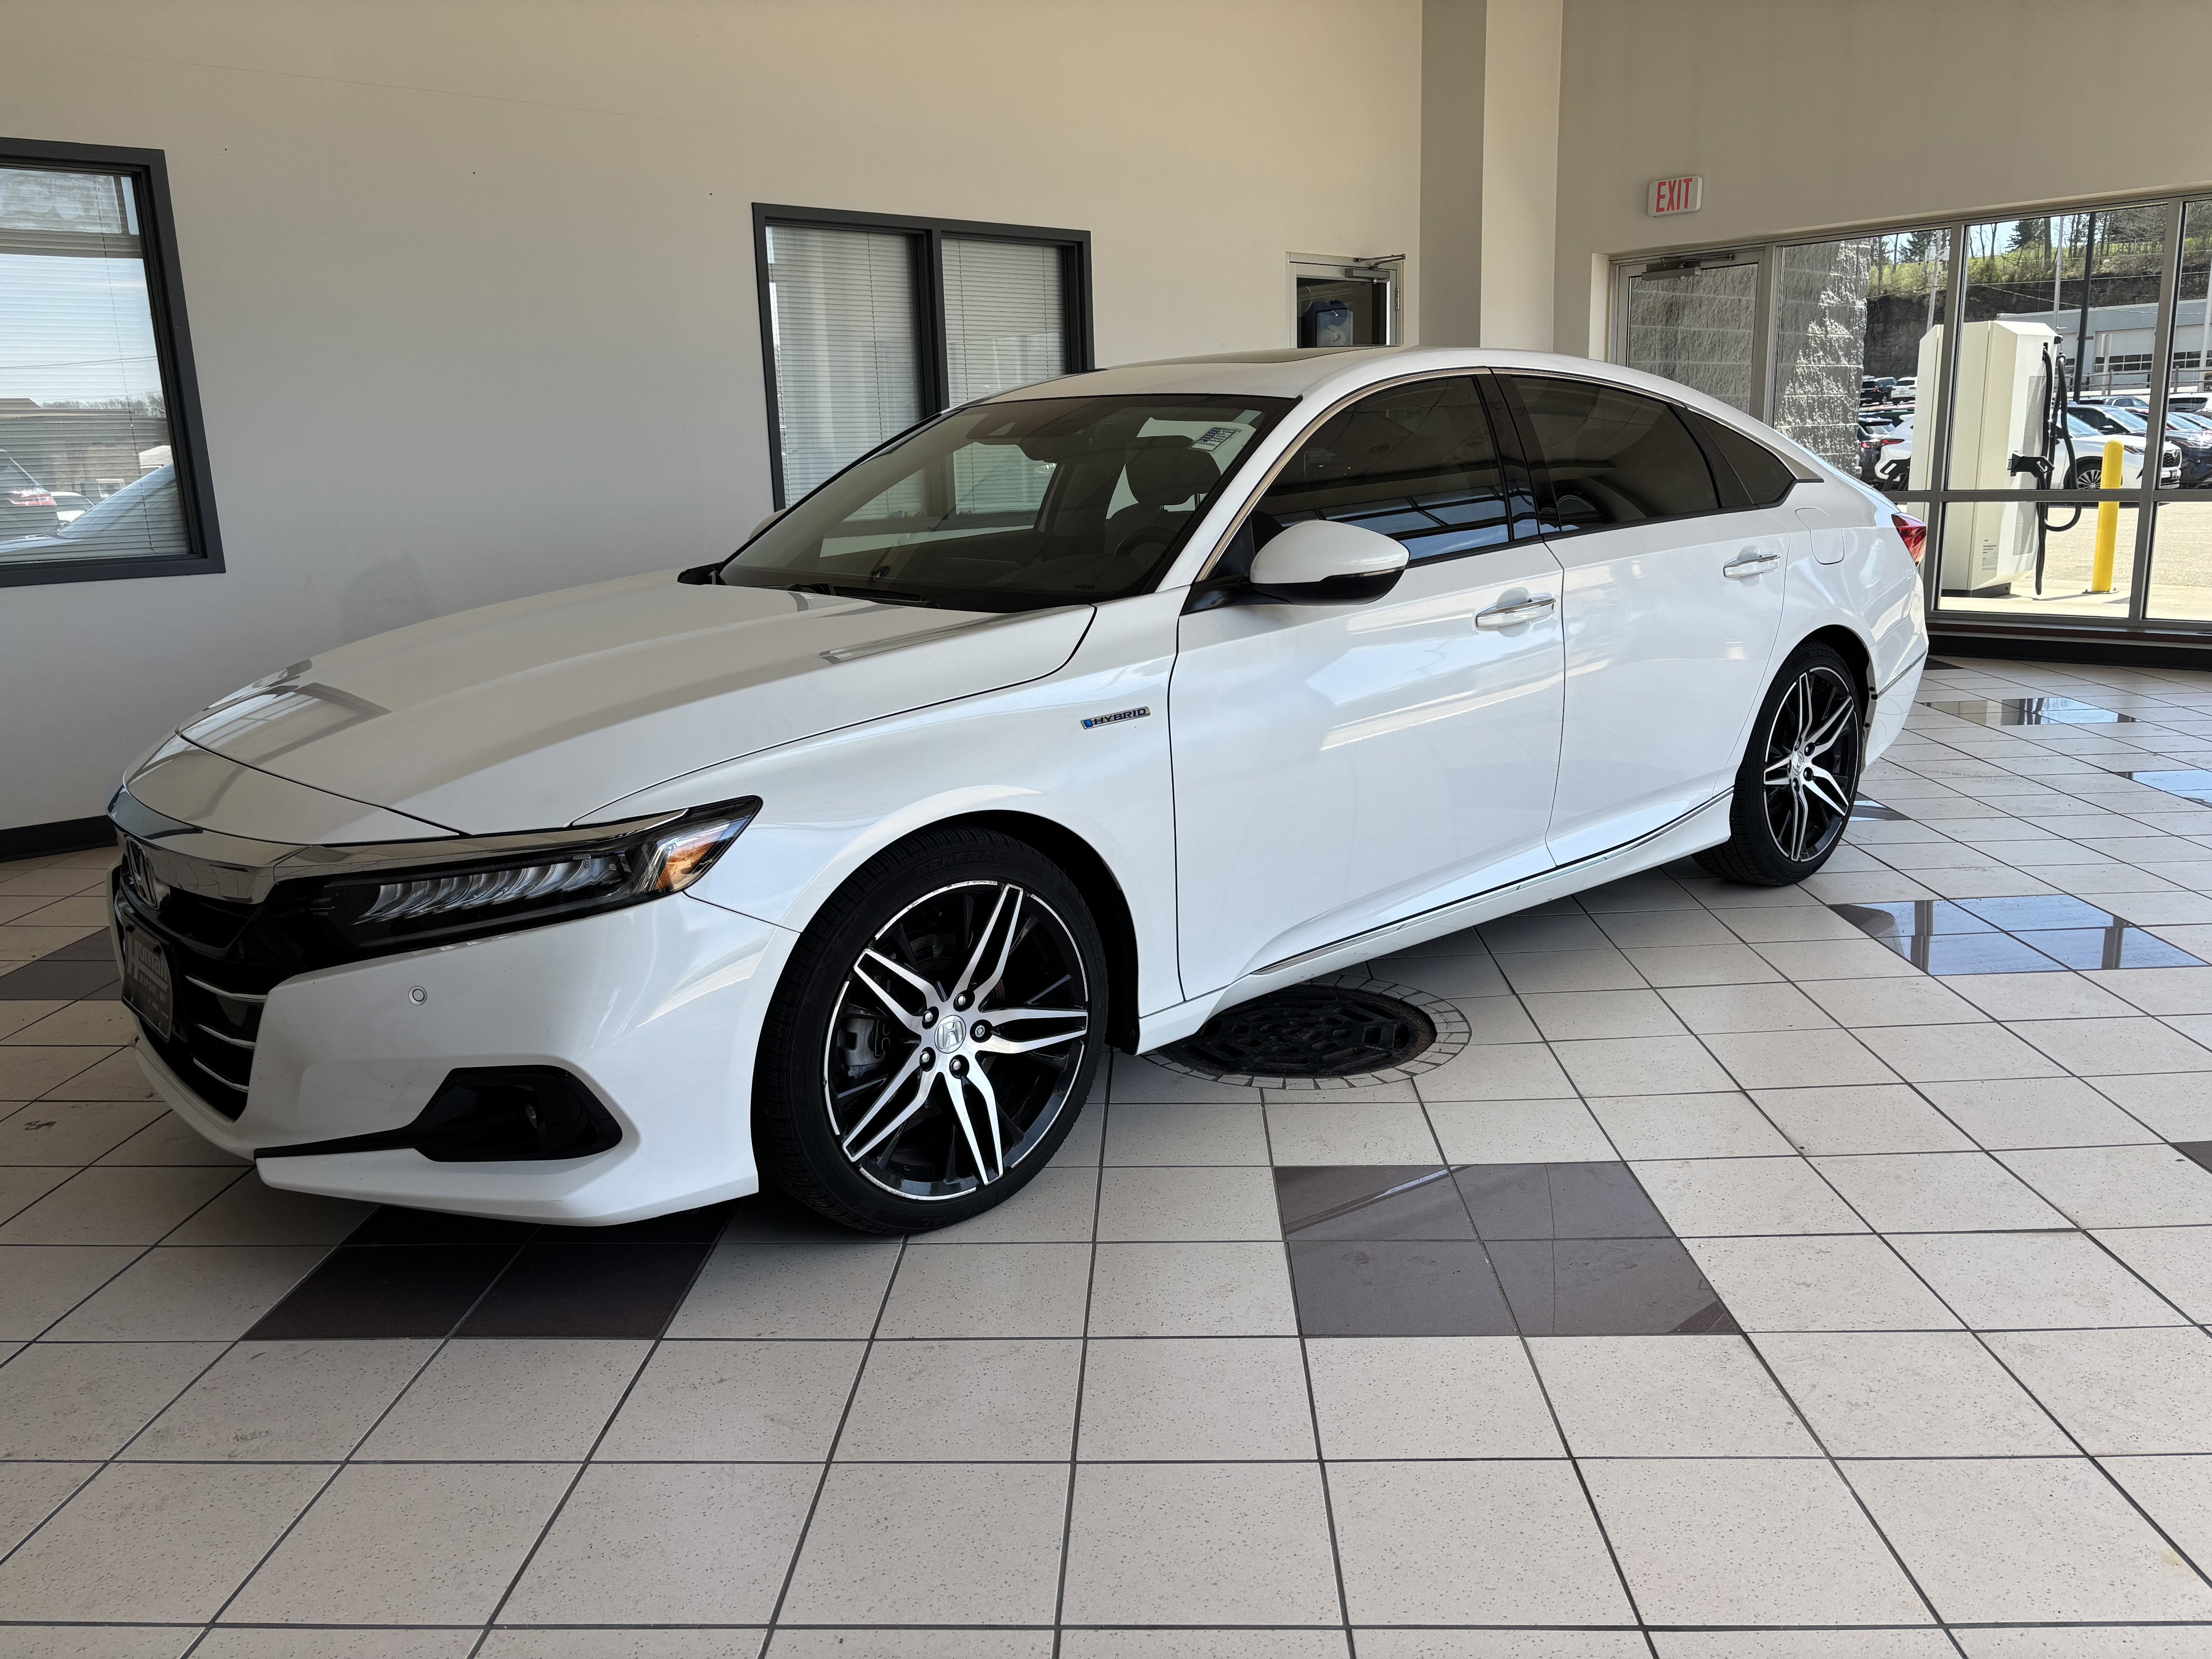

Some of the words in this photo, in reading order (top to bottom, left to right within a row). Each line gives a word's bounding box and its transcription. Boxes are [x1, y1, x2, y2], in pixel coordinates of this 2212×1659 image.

[1656, 178, 1693, 213] EXIT
[1809, 650, 1840, 663] GENERAL
[1094, 708, 1146, 725] HYBRID
[915, 851, 1005, 878] GENERAL
[127, 933, 168, 988] Homan
[140, 974, 158, 998] RIPON,
[159, 990, 167, 1004] WI
